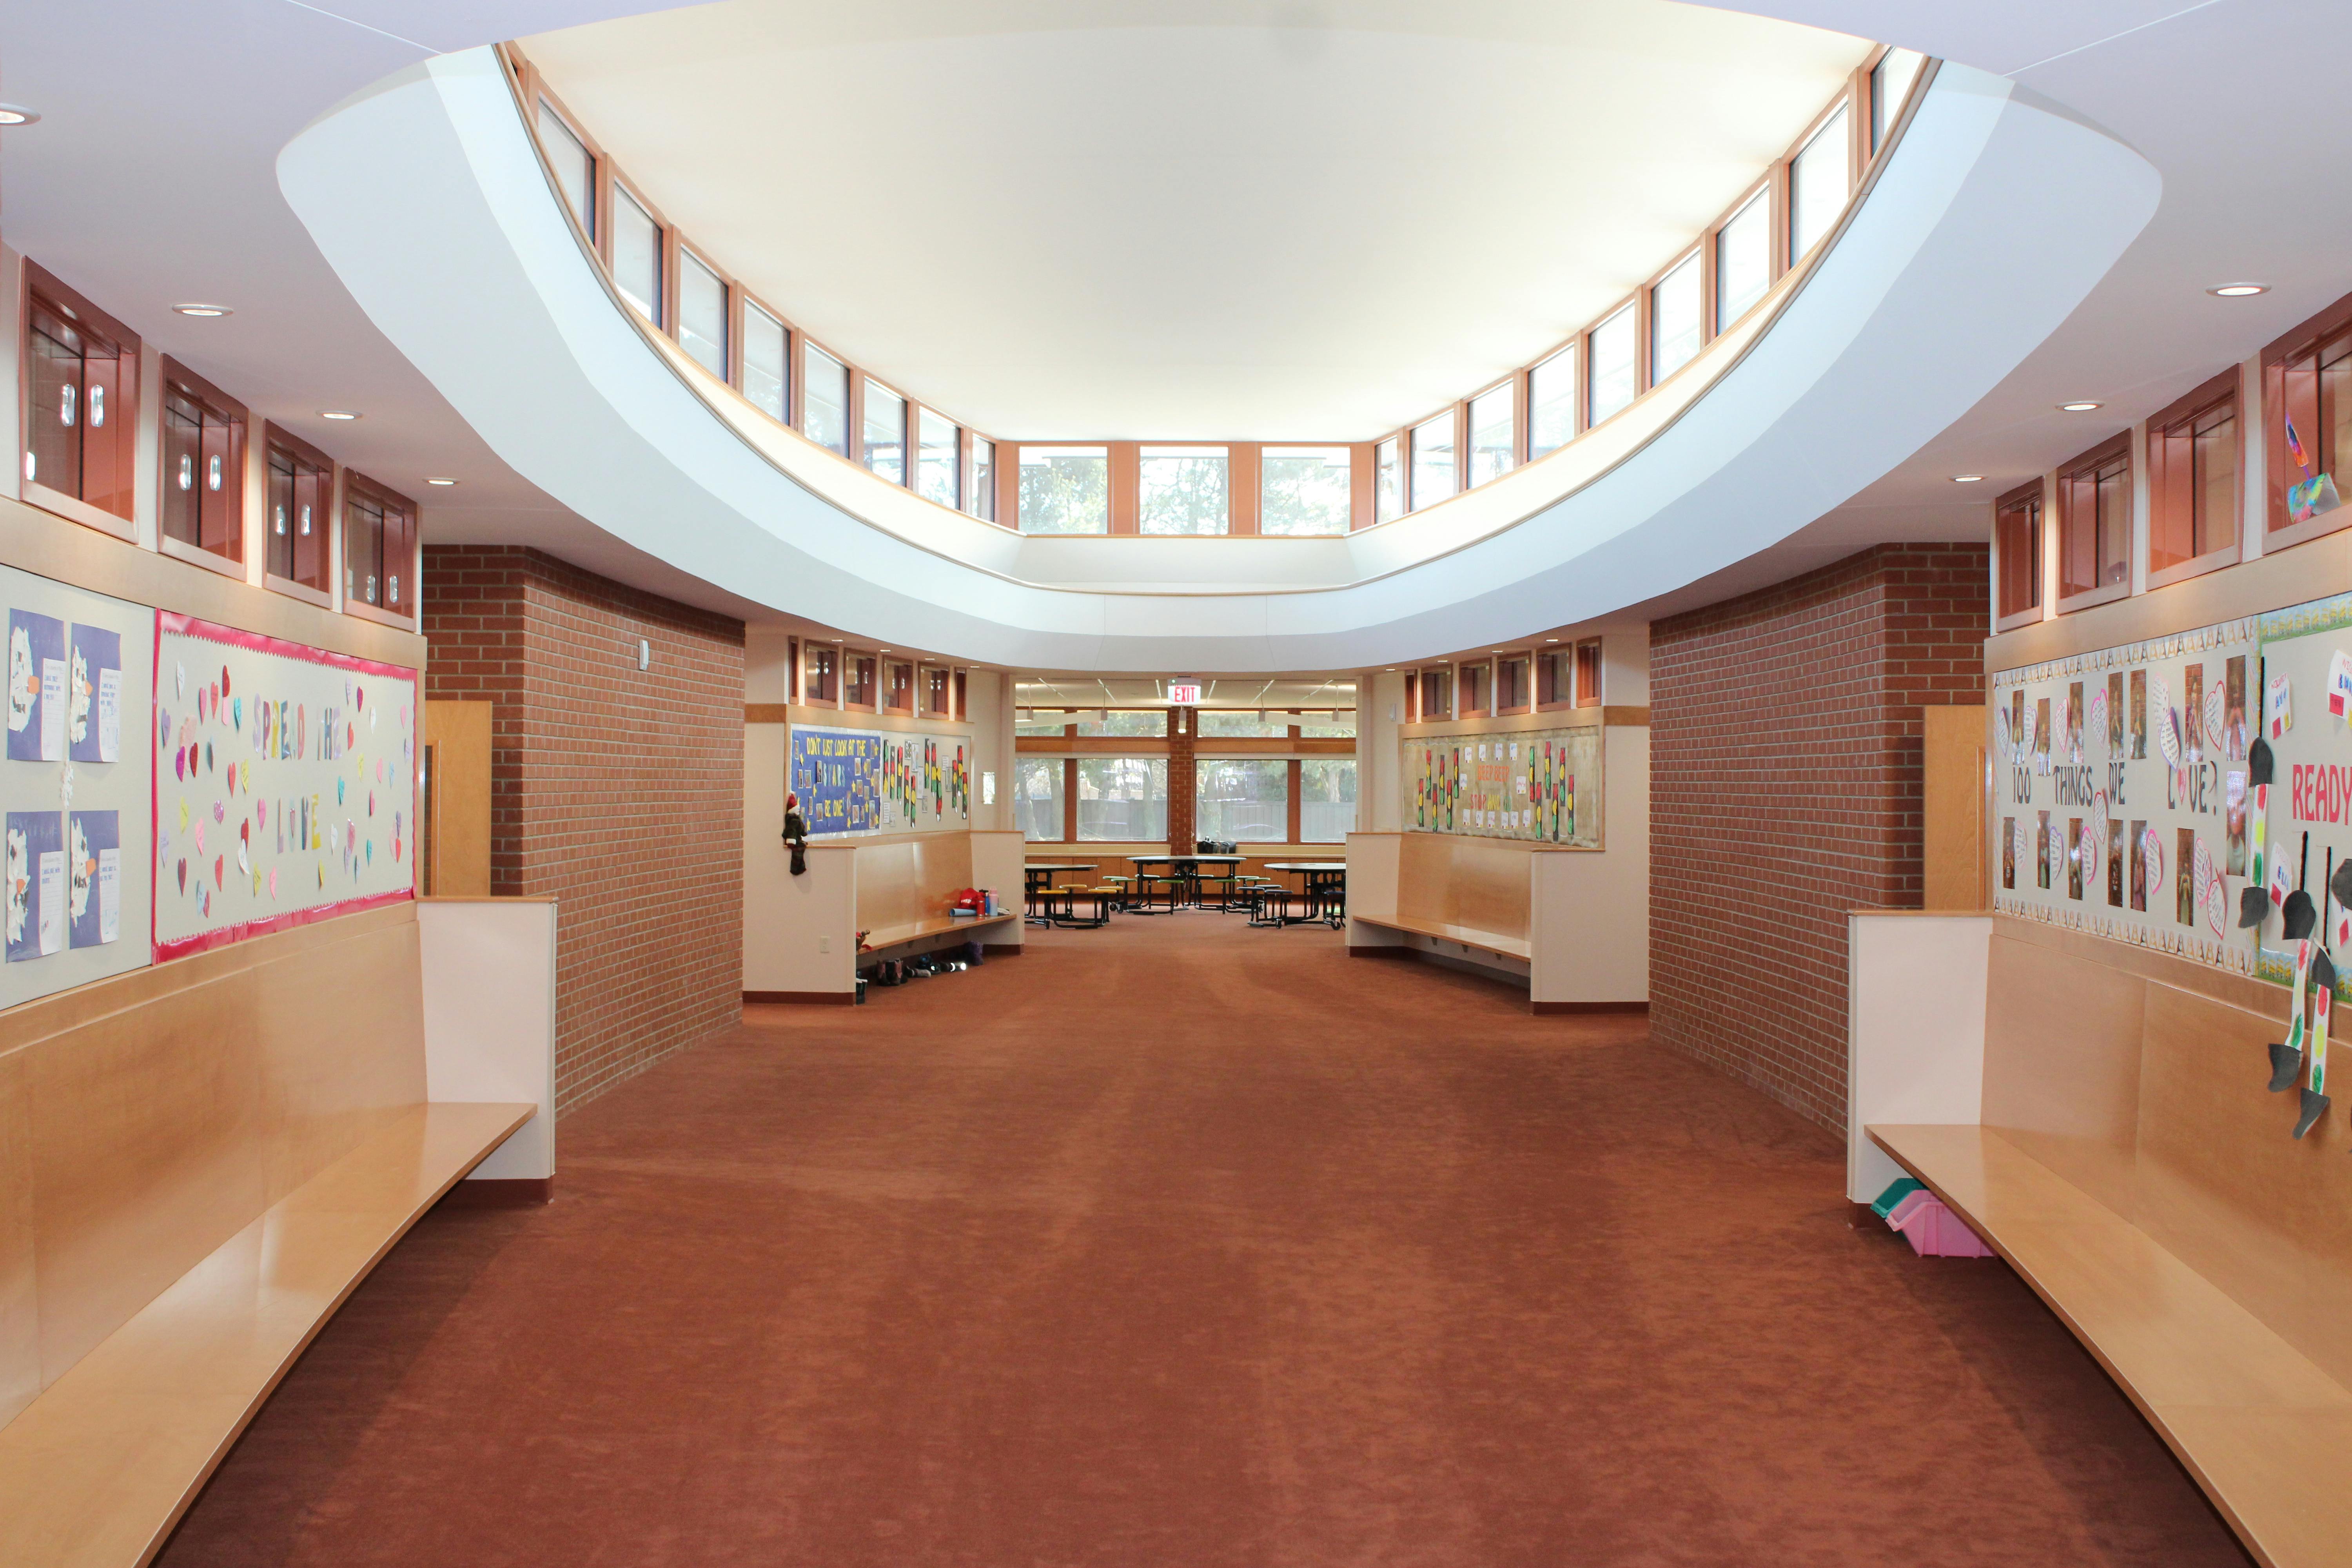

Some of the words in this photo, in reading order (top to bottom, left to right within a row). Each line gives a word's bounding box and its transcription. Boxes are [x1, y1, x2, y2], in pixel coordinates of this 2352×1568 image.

[1174, 687, 1195, 702] EXIT
[253, 693, 305, 761] SPREAD
[317, 707, 342, 761] THE
[835, 739, 847, 757] LOOK
[848, 739, 855, 756] AT
[856, 739, 866, 757] THE
[823, 763, 846, 787] STARS
[1478, 765, 1494, 781] BEEP
[1494, 766, 1509, 782] BEEP
[2013, 766, 2031, 804] 100
[2053, 765, 2092, 807] THINGS
[2109, 762, 2125, 805] WE
[1470, 793, 1486, 810] STOP
[1487, 793, 1500, 811] AND
[1504, 795, 1512, 812] GO
[2292, 764, 2352, 826] READY
[825, 799, 831, 818] BE
